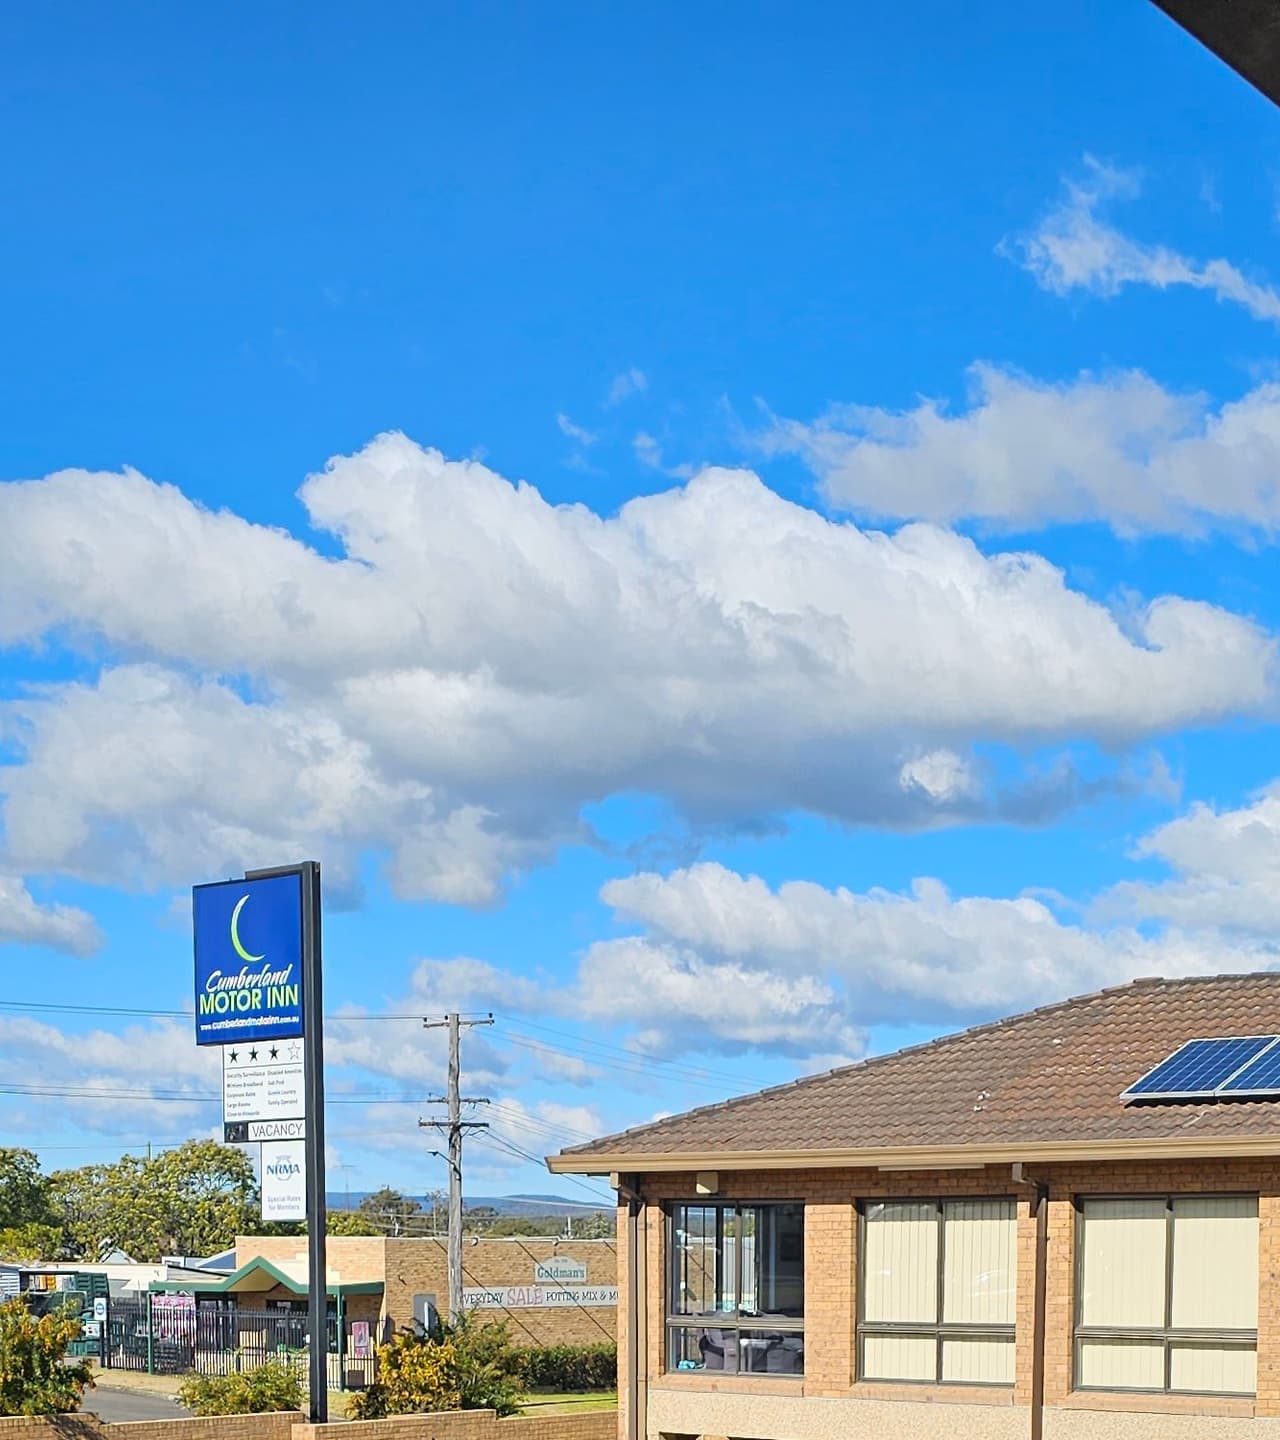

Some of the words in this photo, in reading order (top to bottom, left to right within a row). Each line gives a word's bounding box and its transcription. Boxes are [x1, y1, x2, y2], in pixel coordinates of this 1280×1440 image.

[206, 964, 293, 992] Cumberland
[200, 988, 261, 1015] MOTOR
[267, 984, 298, 1008] INN
[252, 1123, 303, 1138] VACANCY
[267, 1164, 301, 1175] NRMA
[507, 1288, 543, 1306] SALE
[546, 1291, 580, 1302] POTTING
[582, 1291, 598, 1301] MIX
